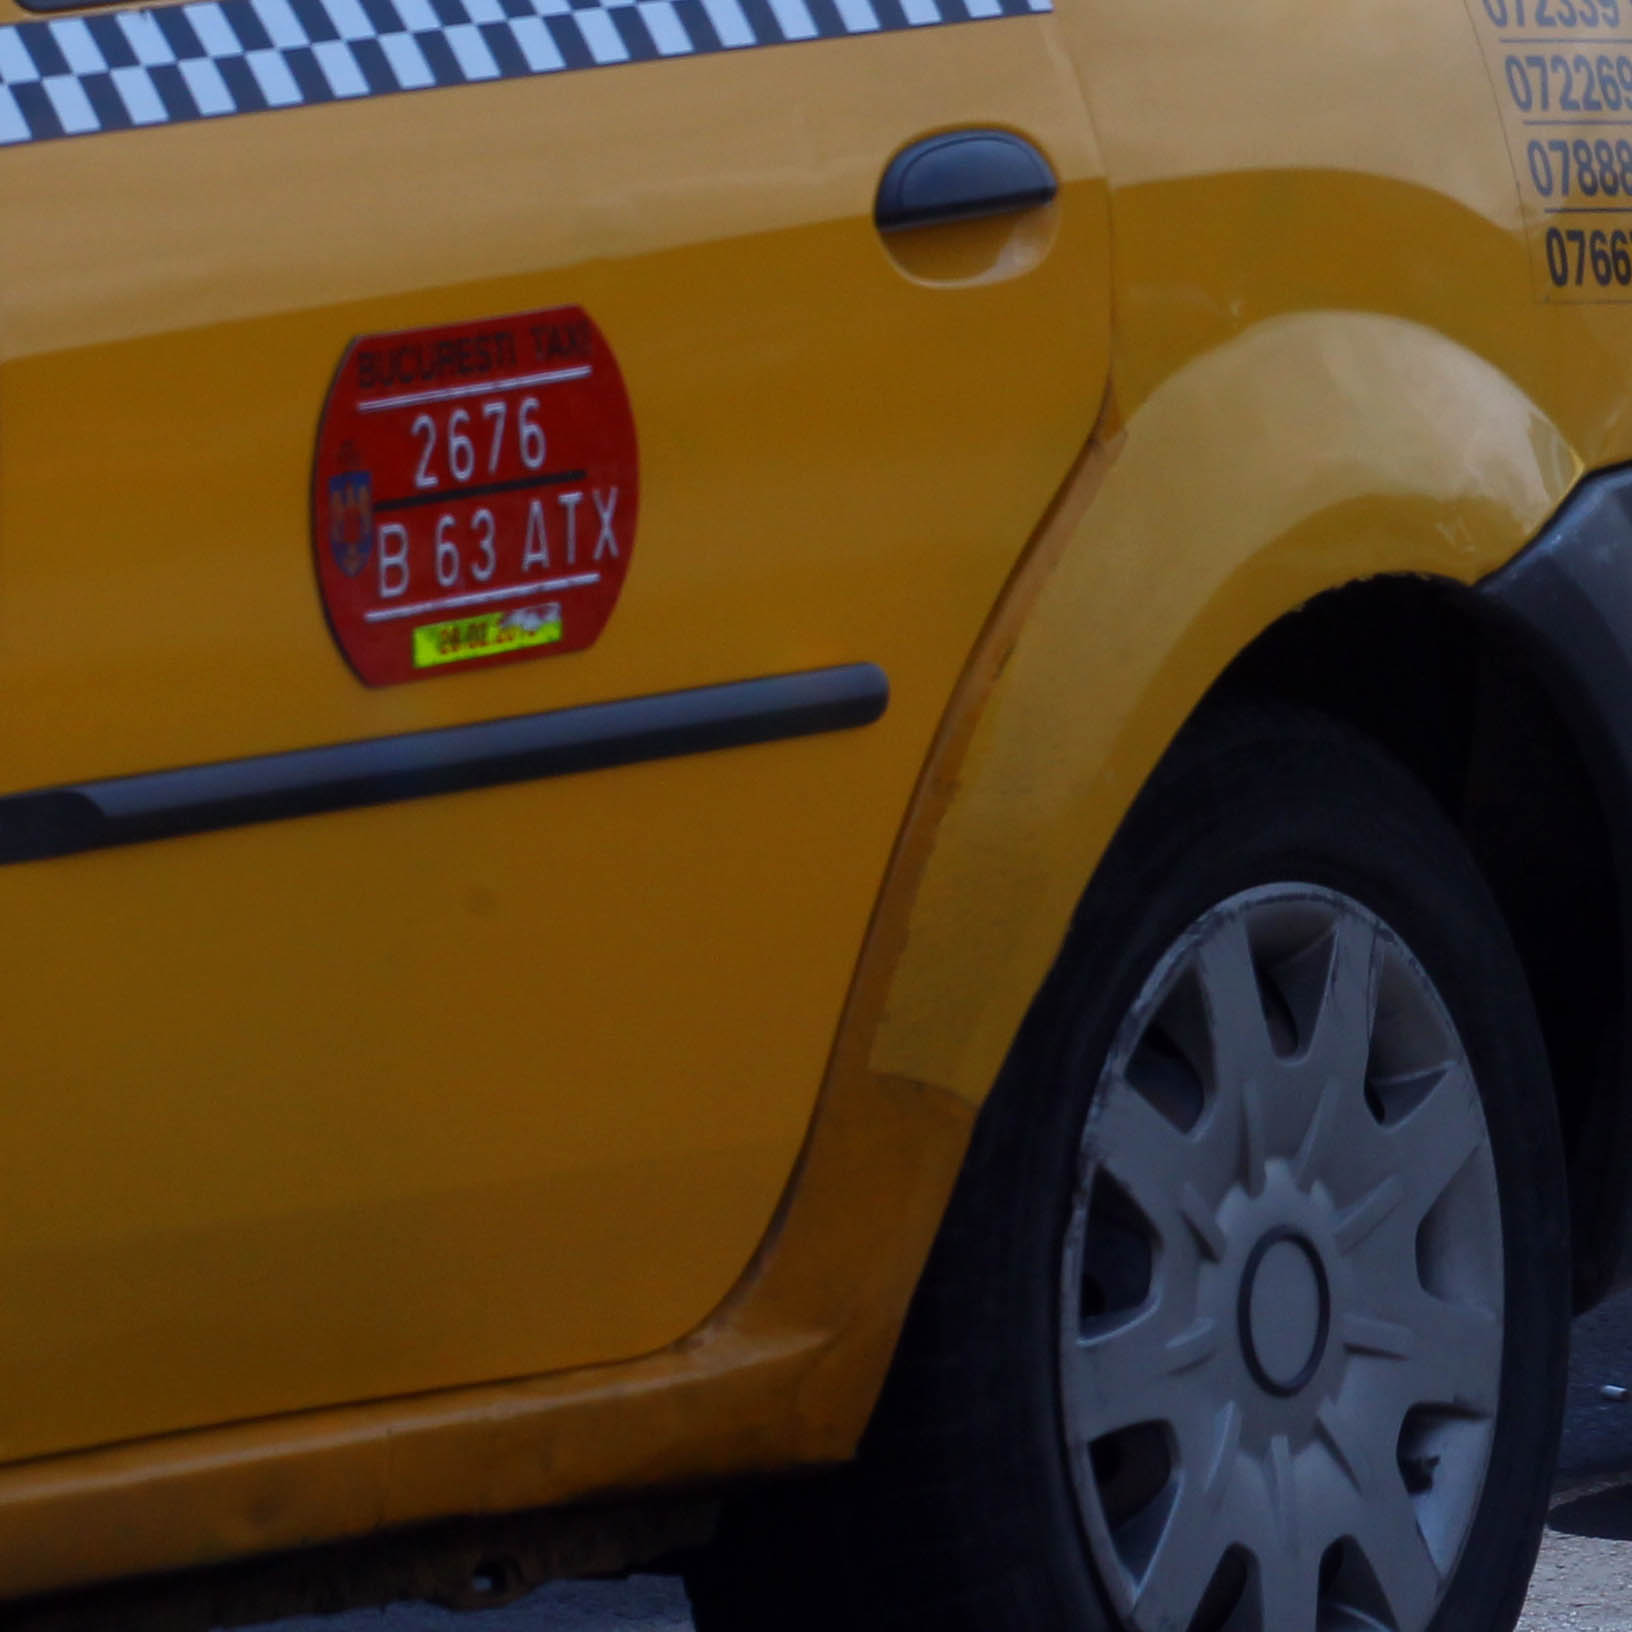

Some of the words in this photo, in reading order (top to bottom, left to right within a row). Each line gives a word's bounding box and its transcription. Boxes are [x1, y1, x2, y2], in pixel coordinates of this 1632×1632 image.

[410, 396, 548, 488] 2676
[377, 523, 410, 598] B
[434, 508, 497, 588] 63
[522, 486, 620, 571] ATX
